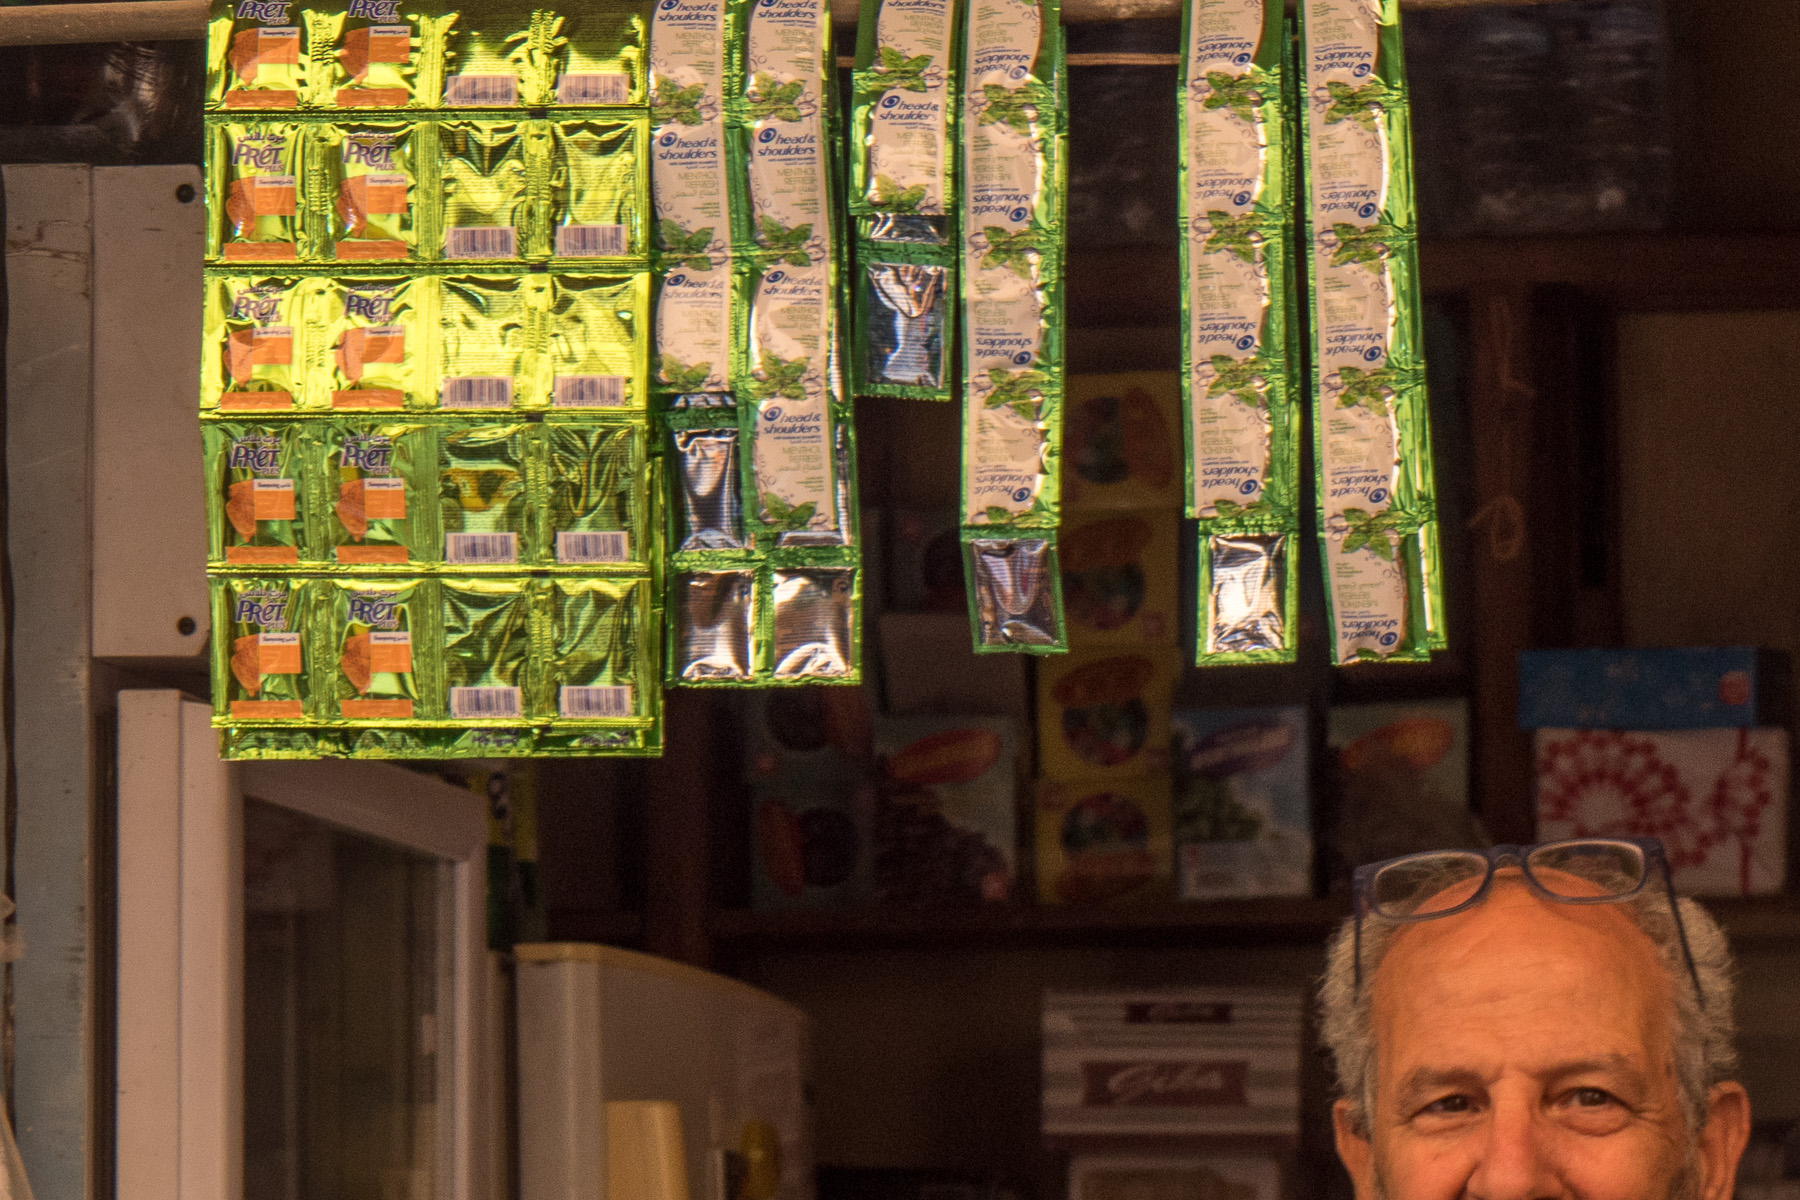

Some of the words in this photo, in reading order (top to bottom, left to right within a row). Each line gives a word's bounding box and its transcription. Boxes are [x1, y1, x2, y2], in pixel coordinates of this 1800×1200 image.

[657, 12, 717, 21] shoulders
[758, 9, 816, 19] shoulders
[1198, 41, 1254, 51] shoulders
[975, 54, 1030, 64] shoulders
[1315, 51, 1373, 62] shoulders
[880, 111, 936, 121] shoulders
[659, 149, 717, 160] shoulders
[758, 146, 816, 157] shoulders
[1197, 178, 1253, 188] shoulders
[973, 192, 1029, 203] shoulders
[1320, 189, 1378, 200] shoulders
[665, 289, 722, 299] shoulders
[764, 286, 822, 296] shoulders
[1199, 321, 1256, 332] shoulders
[976, 338, 1032, 346] shoulders
[1326, 332, 1383, 343] shoulders
[764, 424, 820, 434] shoulders
[1202, 466, 1258, 476] shoulders
[976, 475, 1033, 483] shoulders
[1331, 474, 1388, 485] shoulders
[1342, 618, 1398, 630] shoulders
